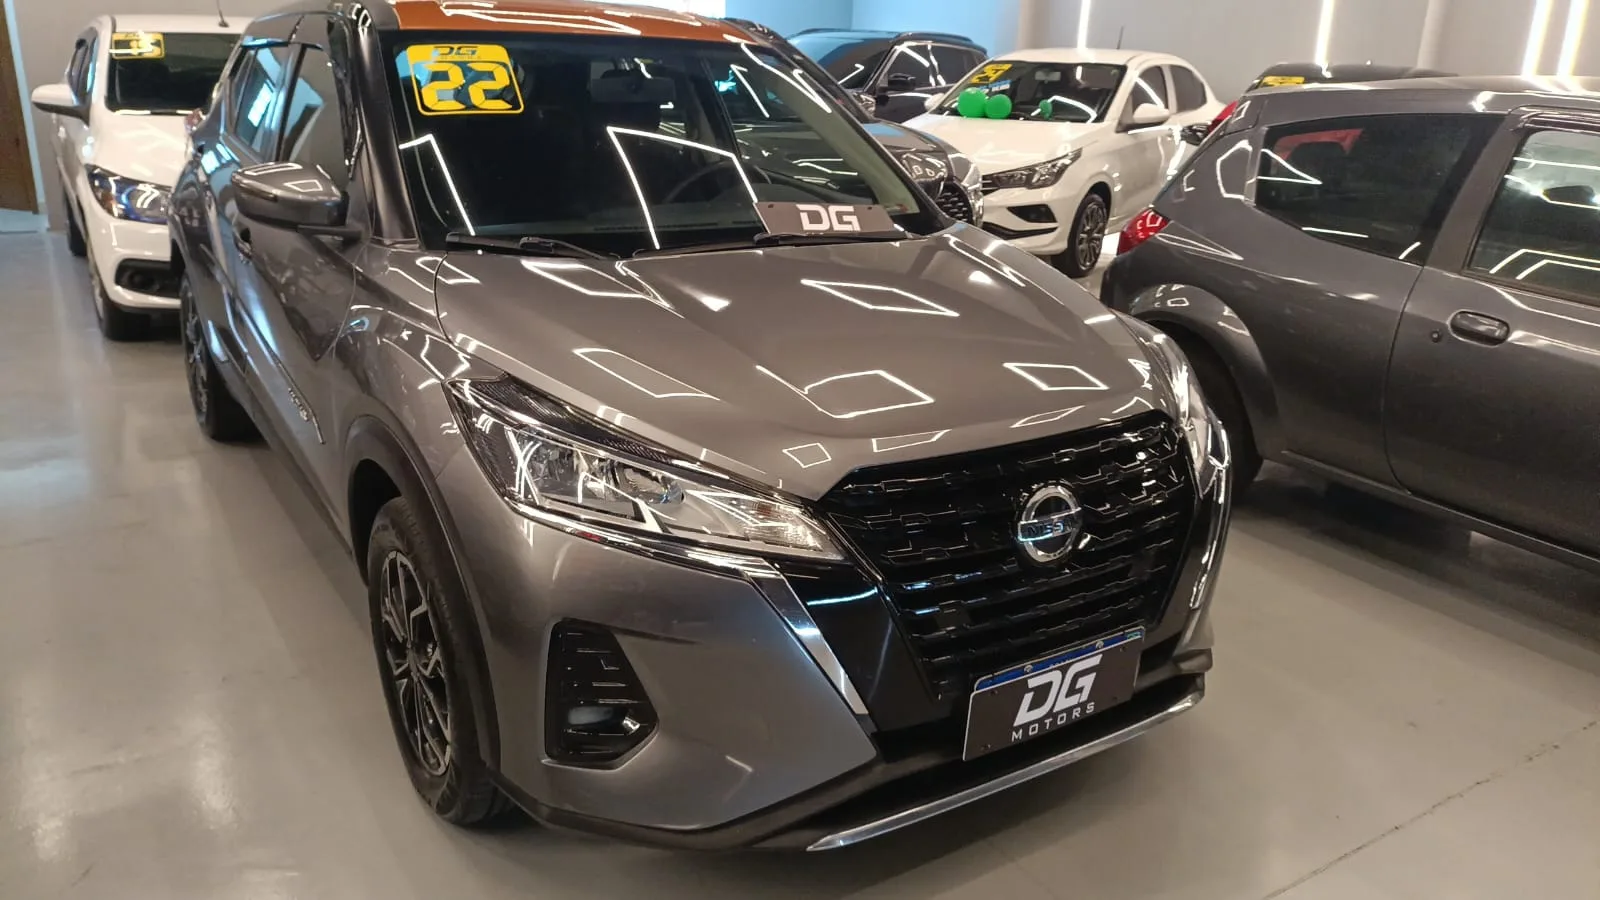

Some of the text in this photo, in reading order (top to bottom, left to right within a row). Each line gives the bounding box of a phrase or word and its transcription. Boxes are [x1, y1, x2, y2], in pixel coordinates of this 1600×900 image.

[422, 62, 513, 111] 22
[795, 203, 861, 232] DG
[1013, 653, 1103, 727] DG
[1011, 702, 1095, 742] MOTORS
